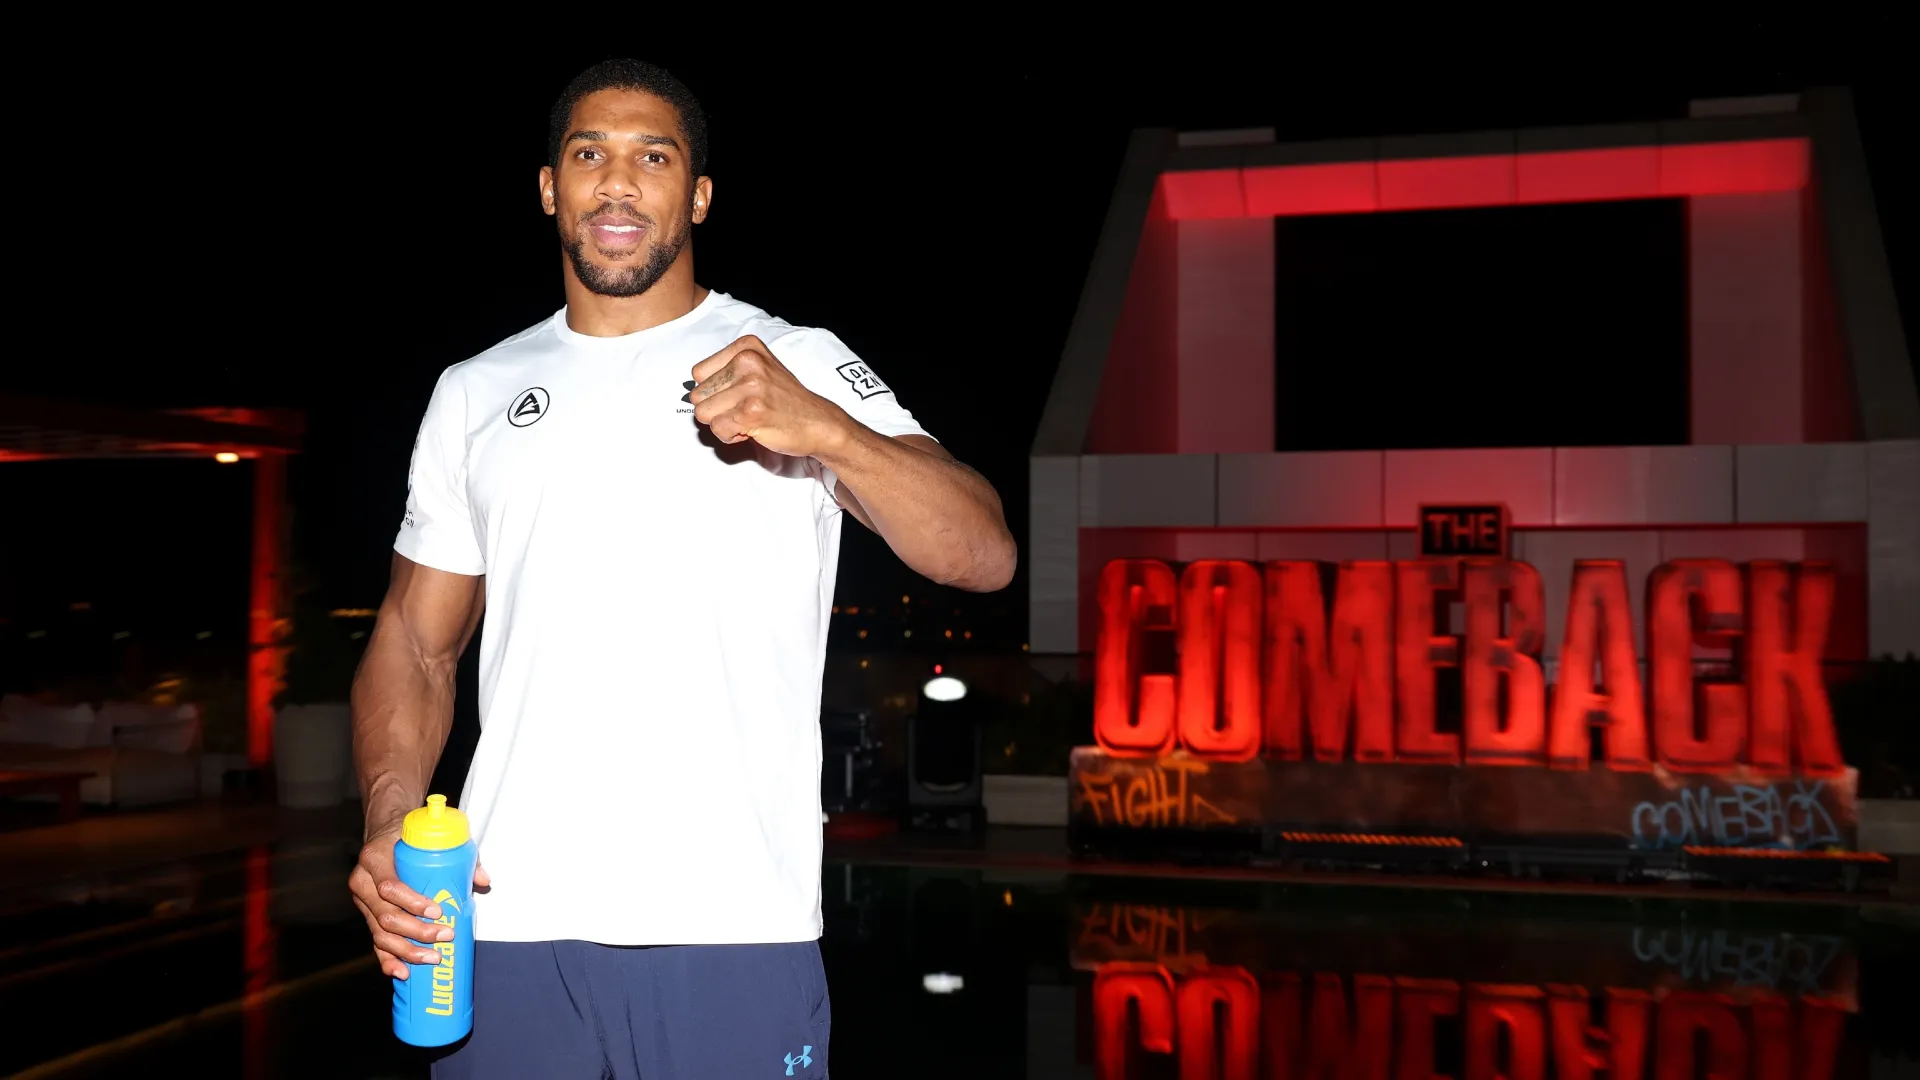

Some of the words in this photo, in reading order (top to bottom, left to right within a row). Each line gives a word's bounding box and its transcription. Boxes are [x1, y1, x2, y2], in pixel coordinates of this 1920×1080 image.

[1427, 513, 1496, 549] THE
[1094, 557, 1845, 777] COMEBACK
[1076, 757, 1208, 826] FIGHT
[1632, 779, 1842, 850] COMEBACK
[426, 916, 455, 1016] Lucozae
